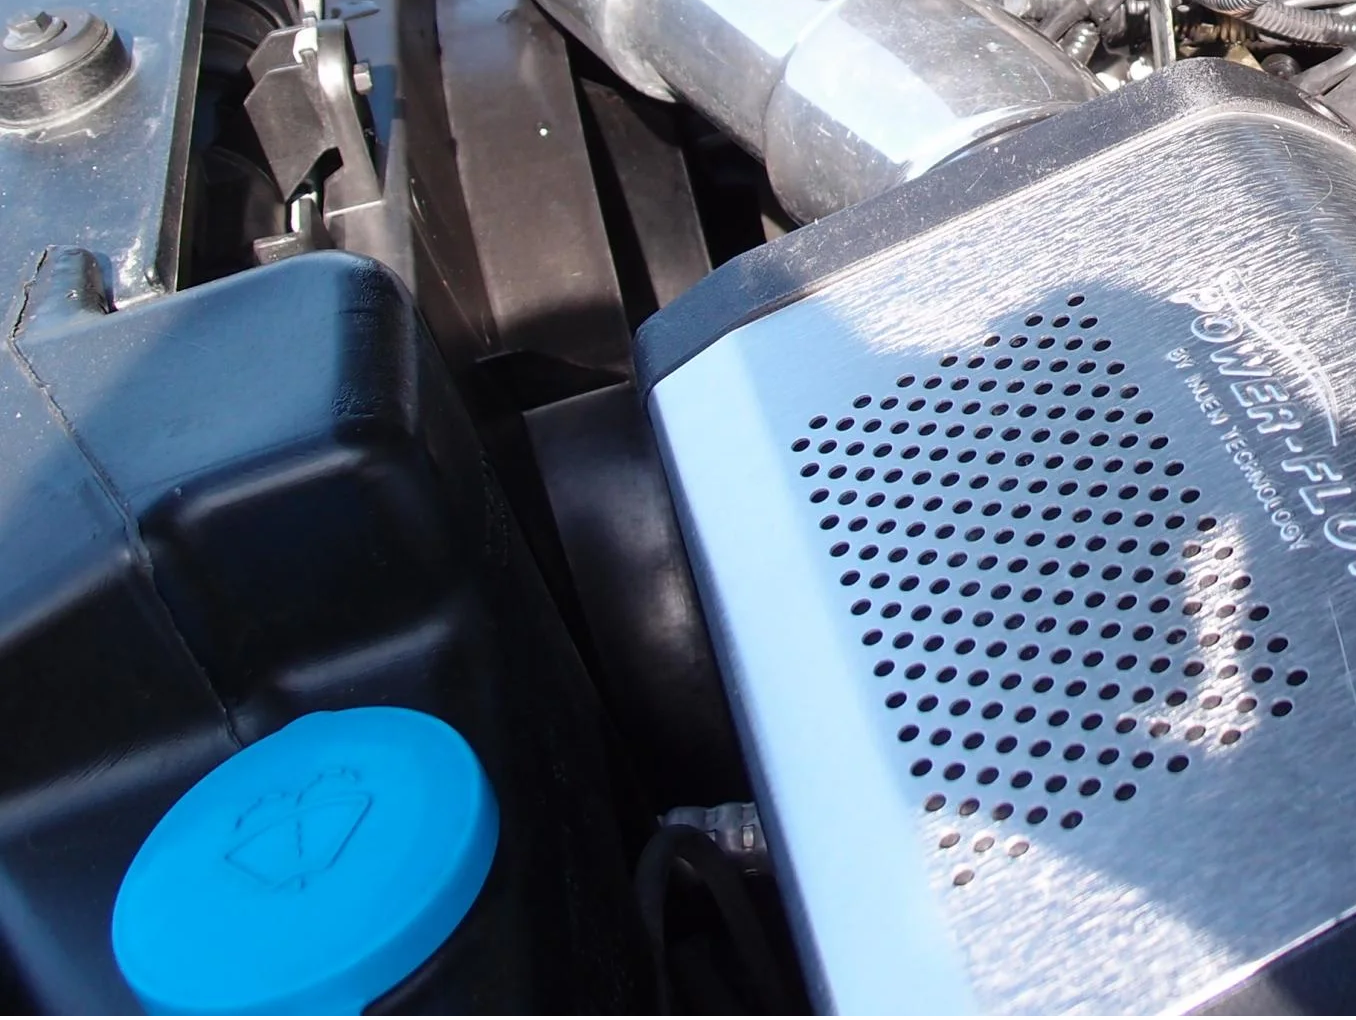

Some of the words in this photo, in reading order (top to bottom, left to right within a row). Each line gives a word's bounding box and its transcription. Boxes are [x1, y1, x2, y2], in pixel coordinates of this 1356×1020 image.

[1166, 346, 1197, 369] BY
[1184, 373, 1232, 425] INJEN
[1220, 425, 1312, 550] TECHNOLOGY
